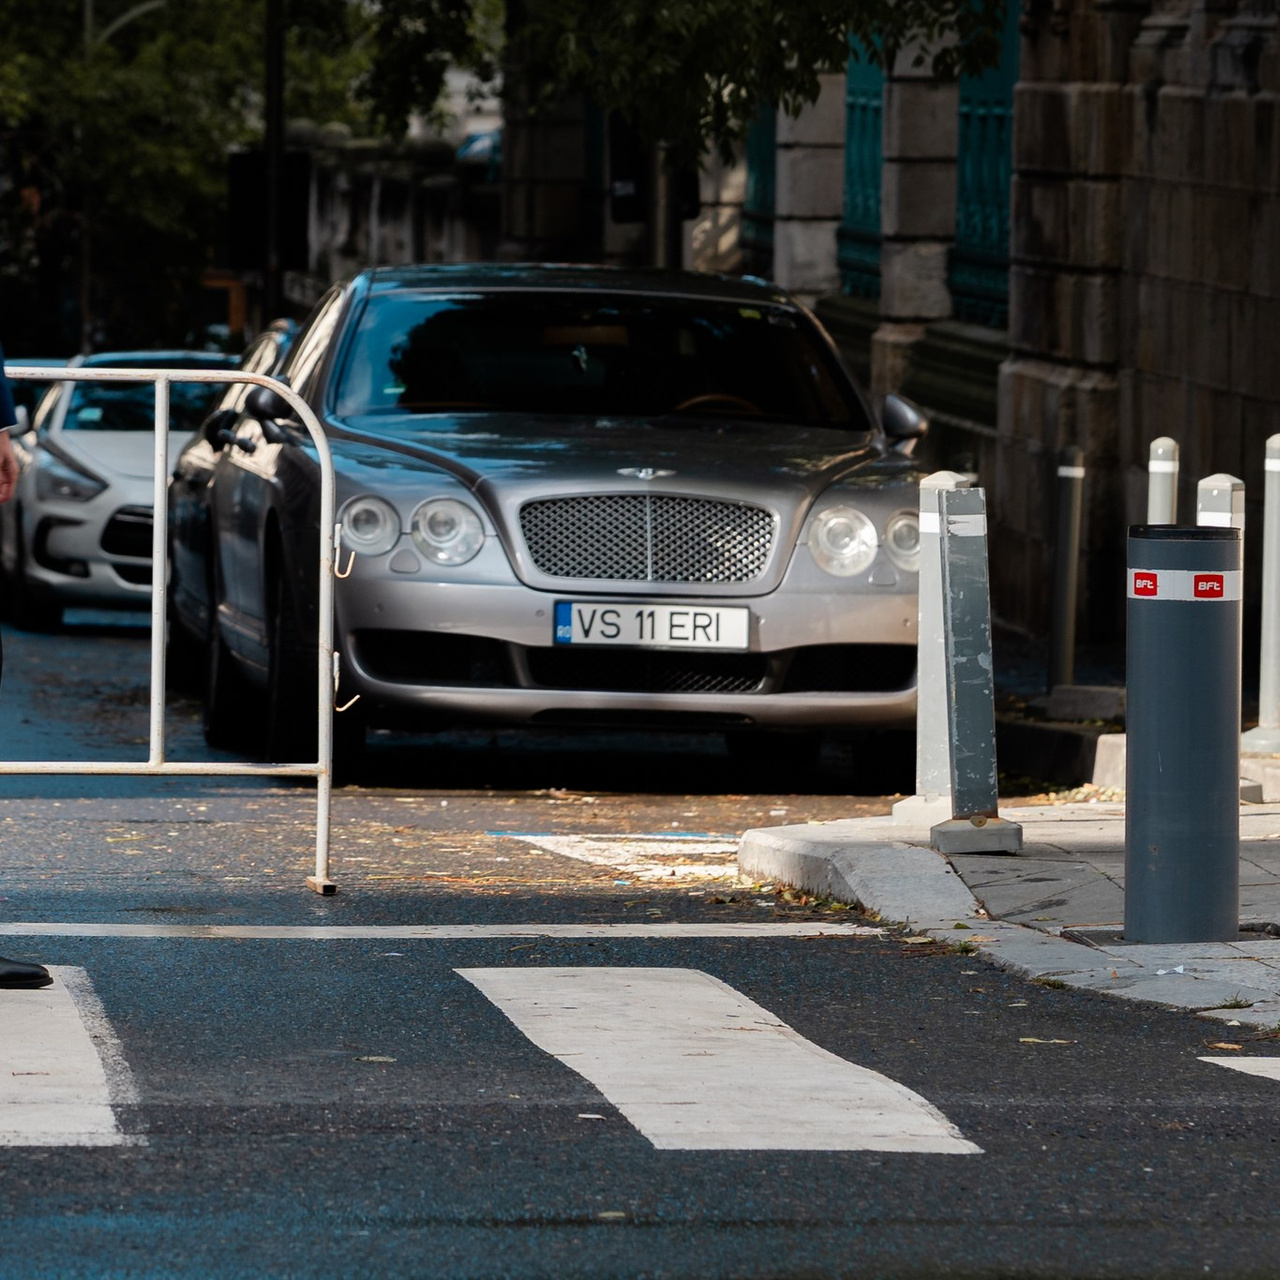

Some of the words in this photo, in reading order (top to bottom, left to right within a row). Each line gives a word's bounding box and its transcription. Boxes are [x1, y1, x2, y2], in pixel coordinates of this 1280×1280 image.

[577, 609, 621, 639] VS
[635, 610, 656, 640] 11
[669, 612, 720, 642] ERI
